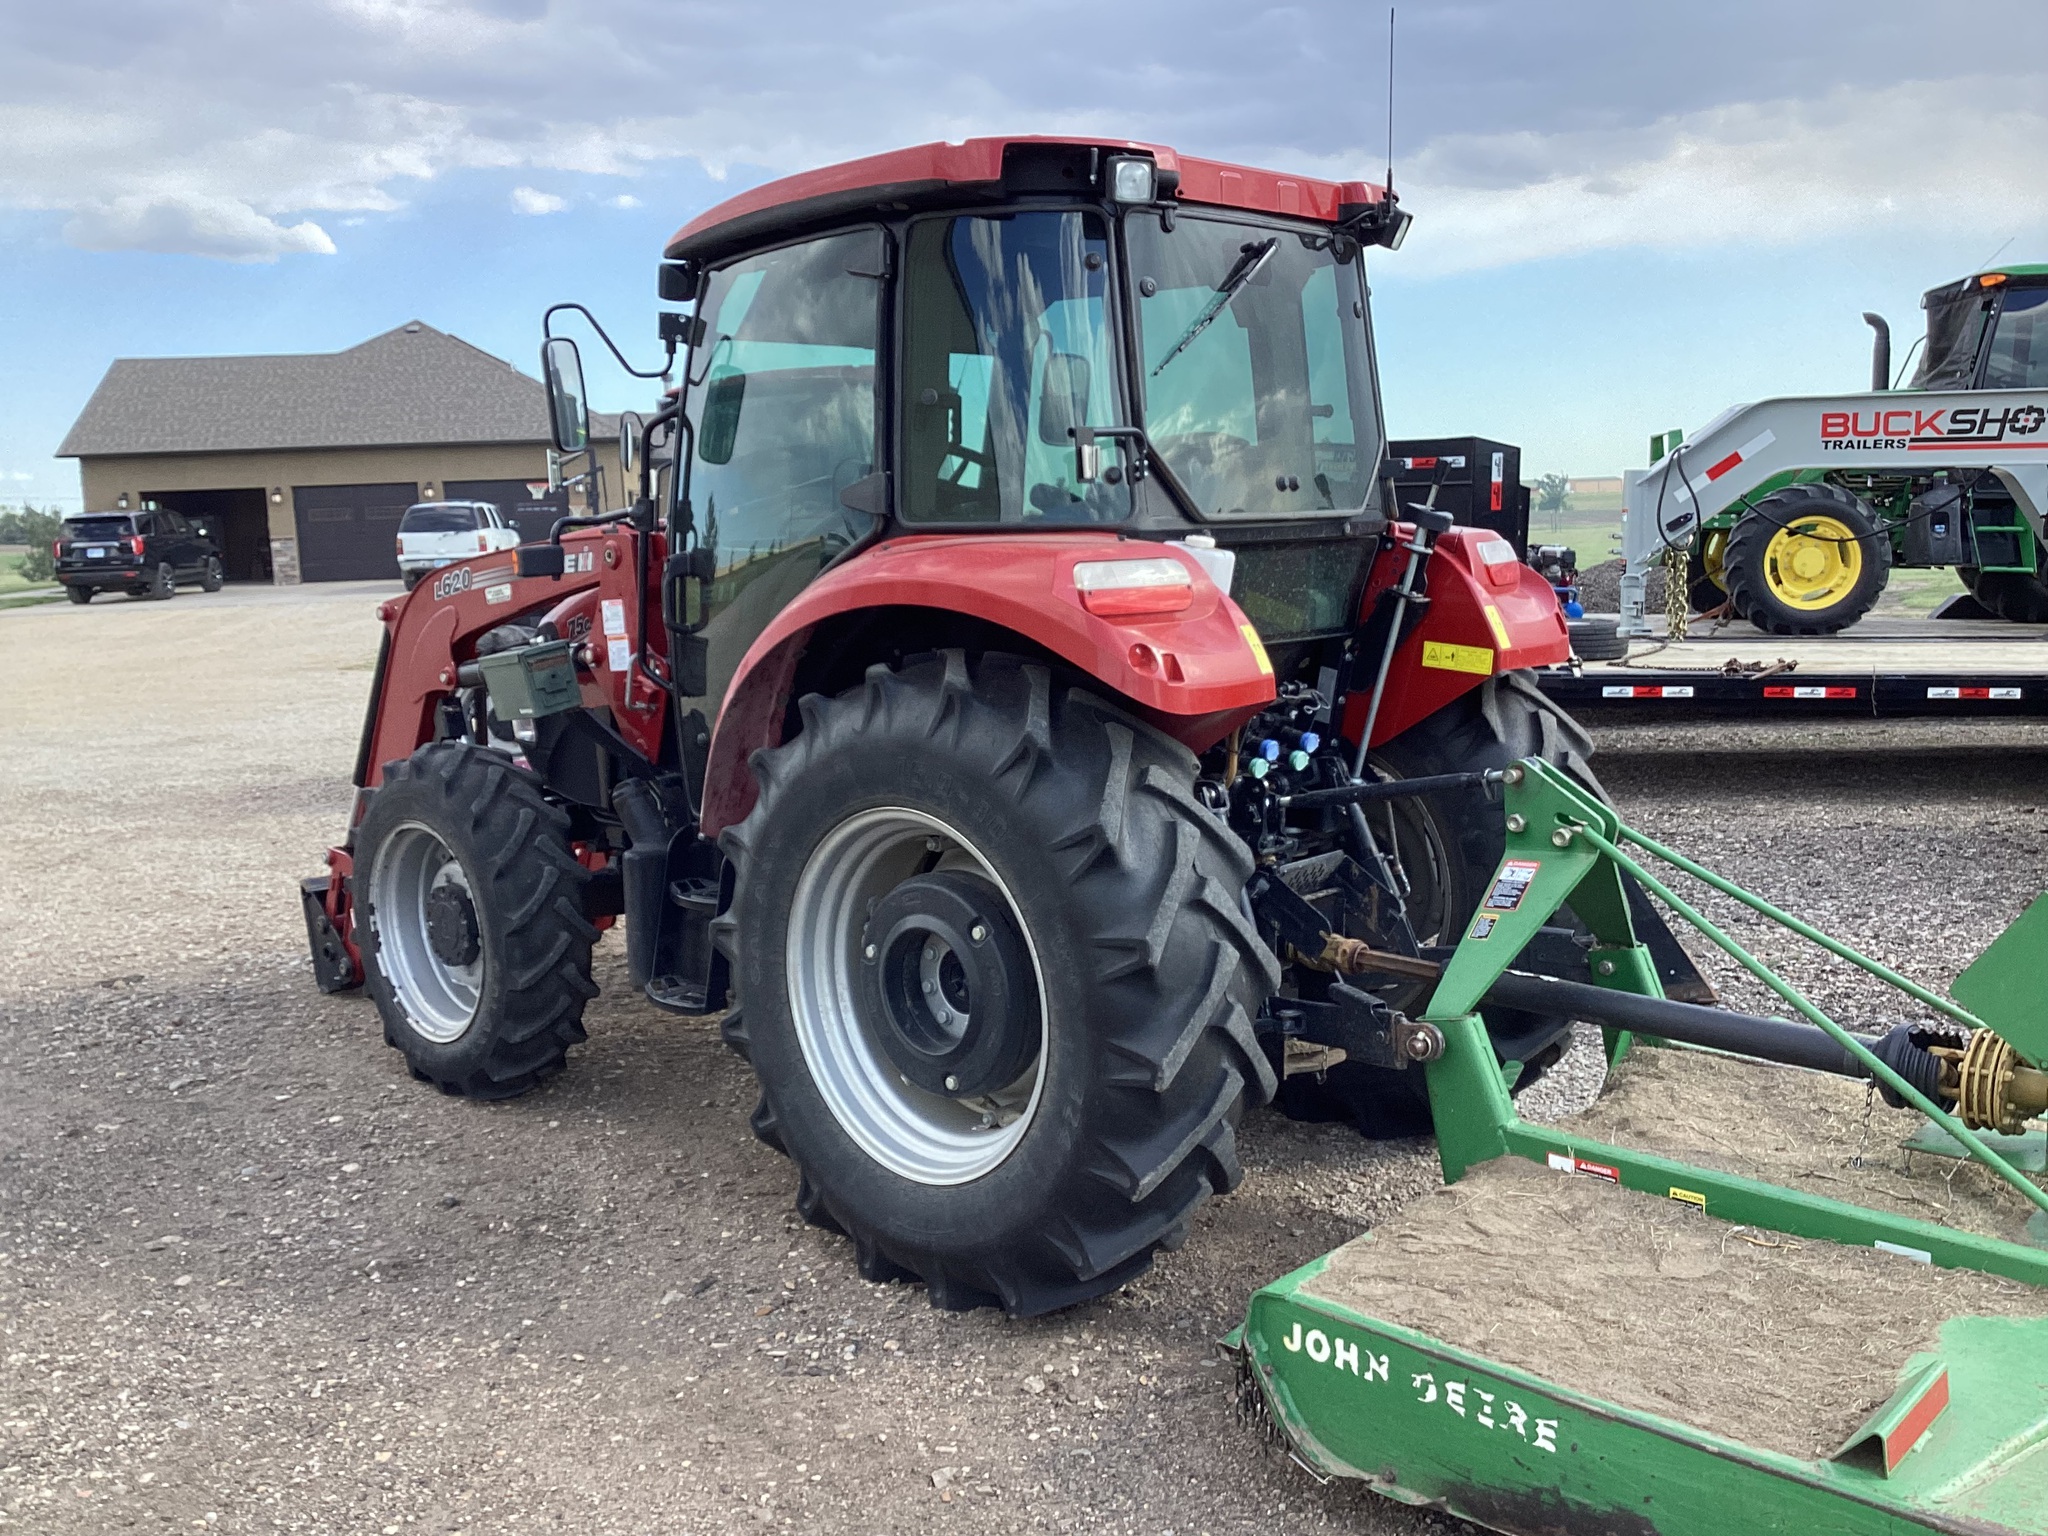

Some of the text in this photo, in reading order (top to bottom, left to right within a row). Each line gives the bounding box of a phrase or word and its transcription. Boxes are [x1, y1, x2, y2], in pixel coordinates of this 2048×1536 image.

[1821, 405, 2048, 440] BUCKSHO
[1821, 438, 1907, 450] TRAILERS
[433, 566, 472, 601] L620
[1586, 1163, 1613, 1176] DANGER
[1678, 1192, 1704, 1203] CAUTION
[1282, 1322, 1559, 1453] JOHN DEERE
